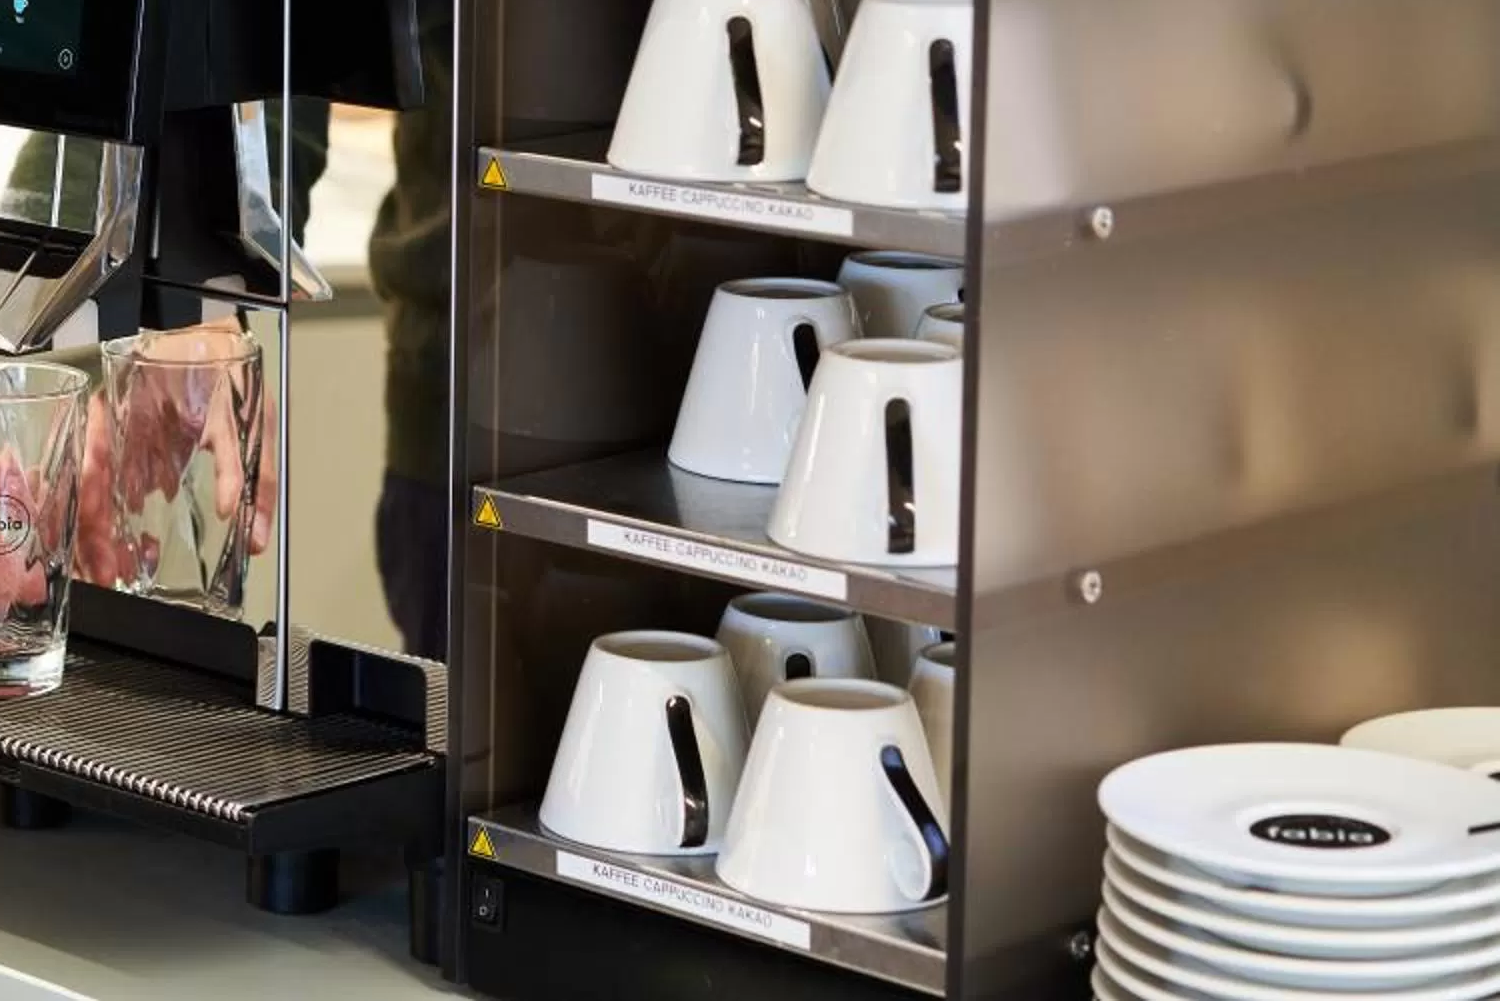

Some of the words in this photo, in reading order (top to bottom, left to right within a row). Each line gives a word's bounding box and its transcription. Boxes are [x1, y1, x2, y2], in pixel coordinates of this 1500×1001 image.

[628, 182, 677, 202] KAFFEE
[681, 189, 764, 215] CAPPUCCINO
[768, 203, 814, 221] KAKAO
[624, 531, 670, 552] KAFFEE
[675, 541, 757, 571] CAPPUCCINO
[762, 561, 808, 582] KAKAO
[1267, 825, 1375, 843] fabia
[592, 862, 639, 888] KAFFEE
[643, 877, 724, 912] CAPPUCCINO
[728, 903, 773, 929] KAKAO
